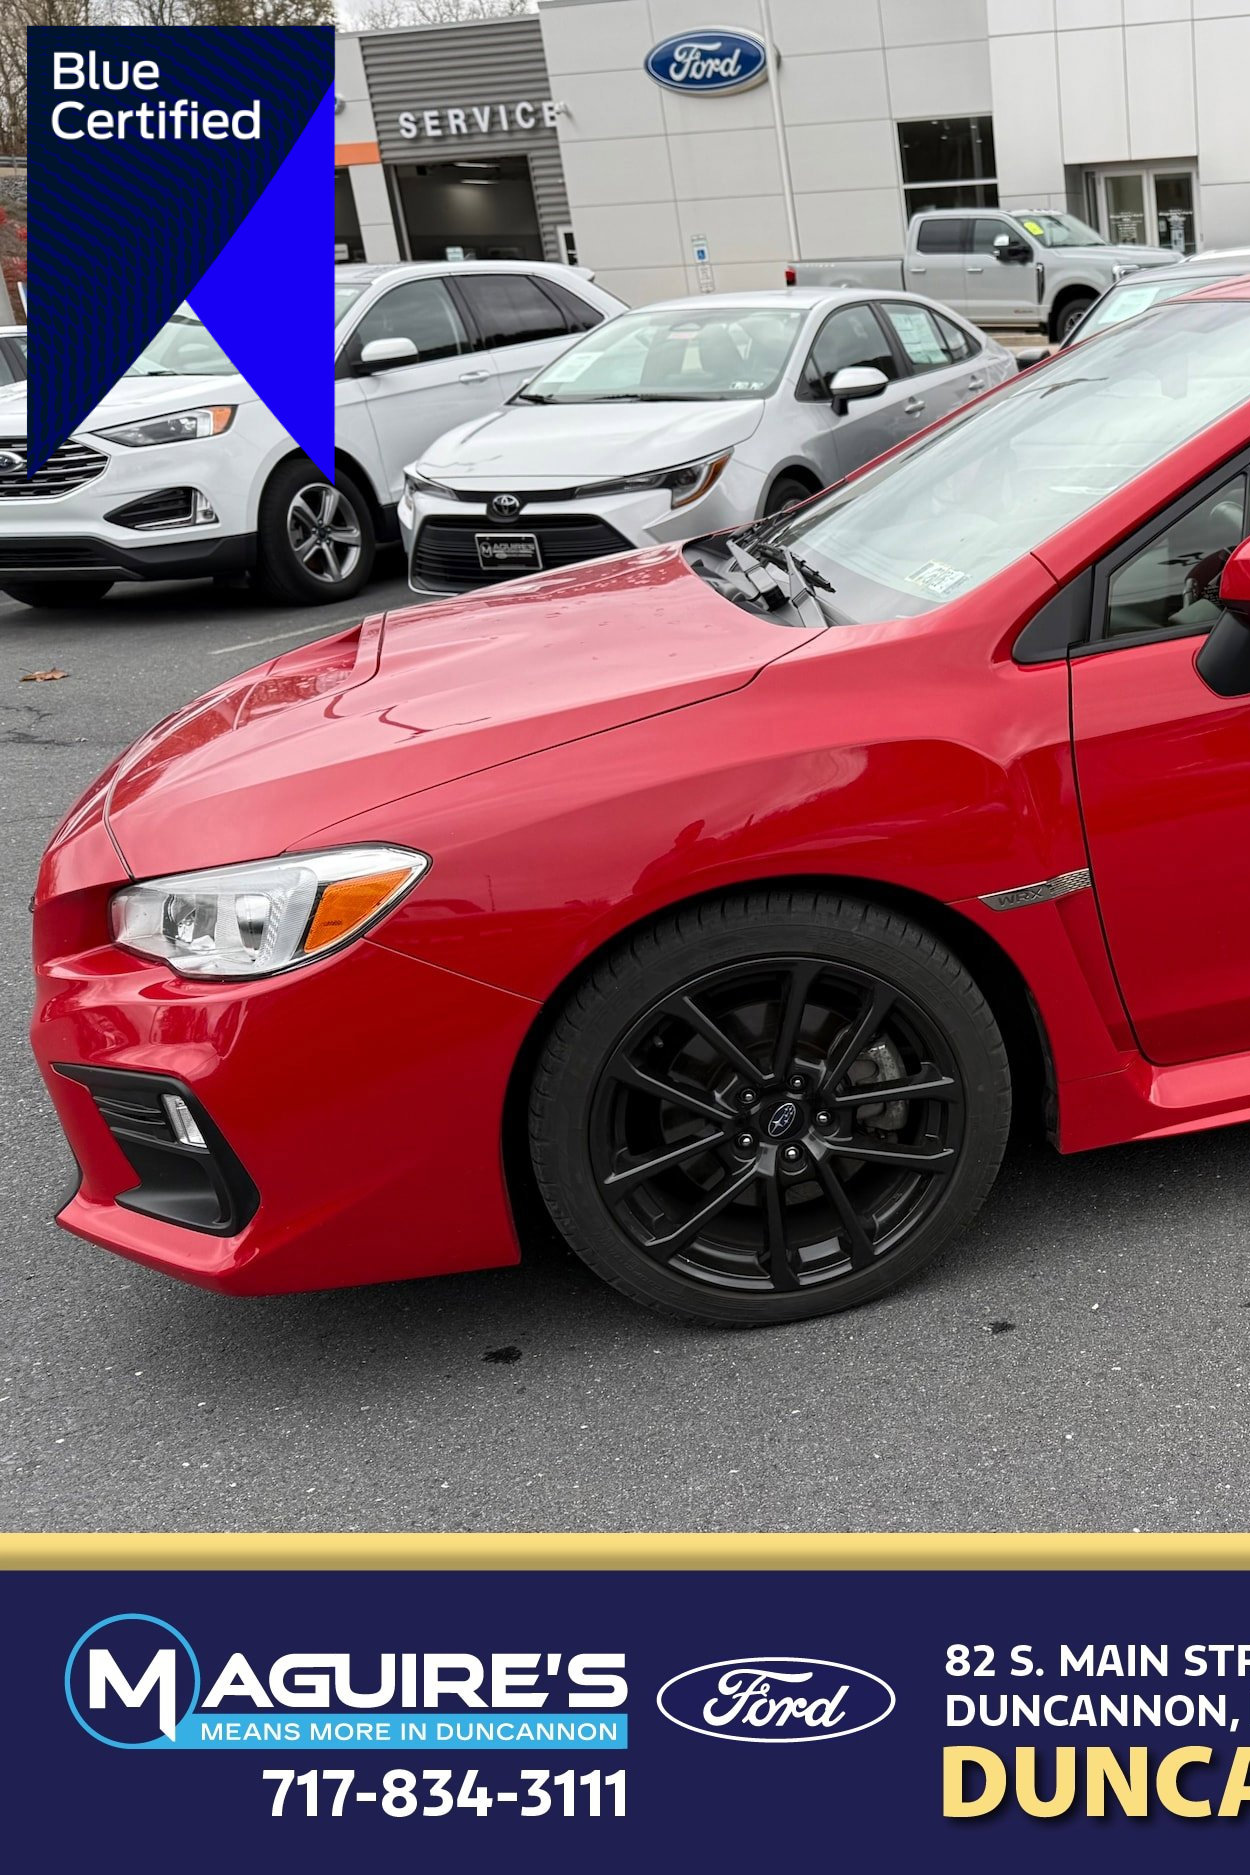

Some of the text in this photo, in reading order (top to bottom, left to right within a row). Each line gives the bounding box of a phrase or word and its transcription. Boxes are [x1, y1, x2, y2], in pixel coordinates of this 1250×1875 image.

[669, 42, 742, 82] Ford
[398, 101, 558, 139] SERVICE
[998, 888, 1043, 907] WRX
